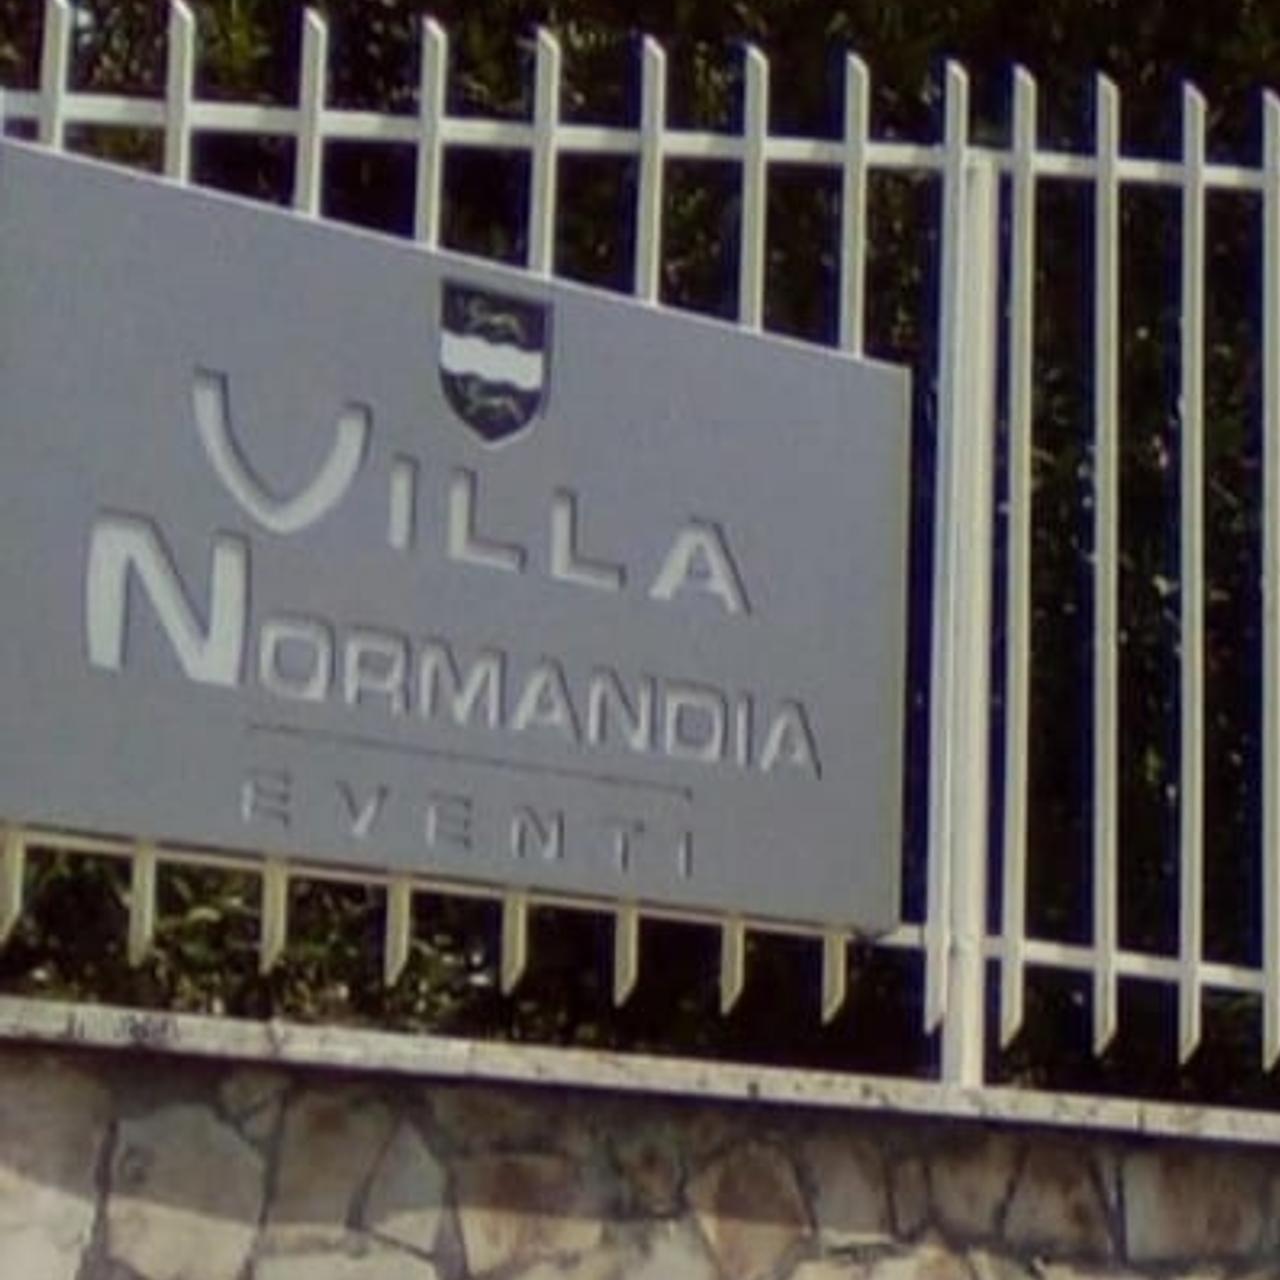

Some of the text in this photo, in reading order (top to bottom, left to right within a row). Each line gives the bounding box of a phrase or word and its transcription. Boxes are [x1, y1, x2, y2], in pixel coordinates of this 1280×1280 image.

[193, 370, 750, 614] VILLA
[84, 511, 822, 779] NORMANDIA
[242, 769, 695, 877] EVENTI
